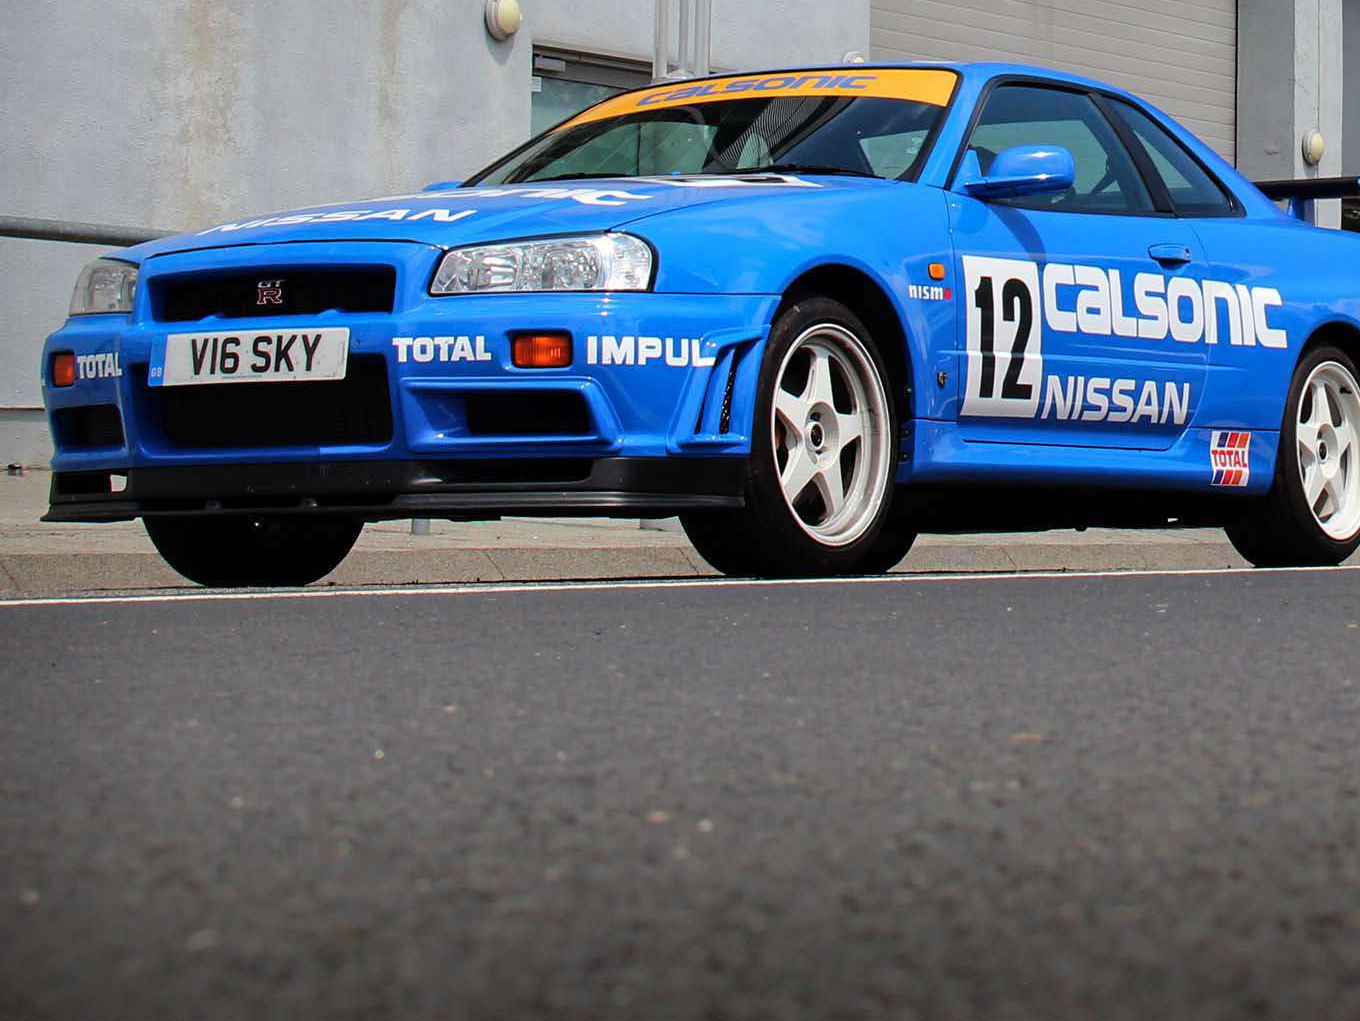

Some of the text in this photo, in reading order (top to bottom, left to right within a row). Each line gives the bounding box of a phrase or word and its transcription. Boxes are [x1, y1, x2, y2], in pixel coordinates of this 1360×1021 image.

[194, 209, 479, 236] NISSAN
[392, 335, 492, 363] TOTAL
[586, 335, 716, 367] IMPUL
[974, 276, 1033, 400] 12
[77, 351, 122, 379] TOTAL
[191, 334, 322, 375] V16 SKY
[1040, 375, 1190, 426] NISSAN
[1211, 449, 1248, 469] TOTAL
